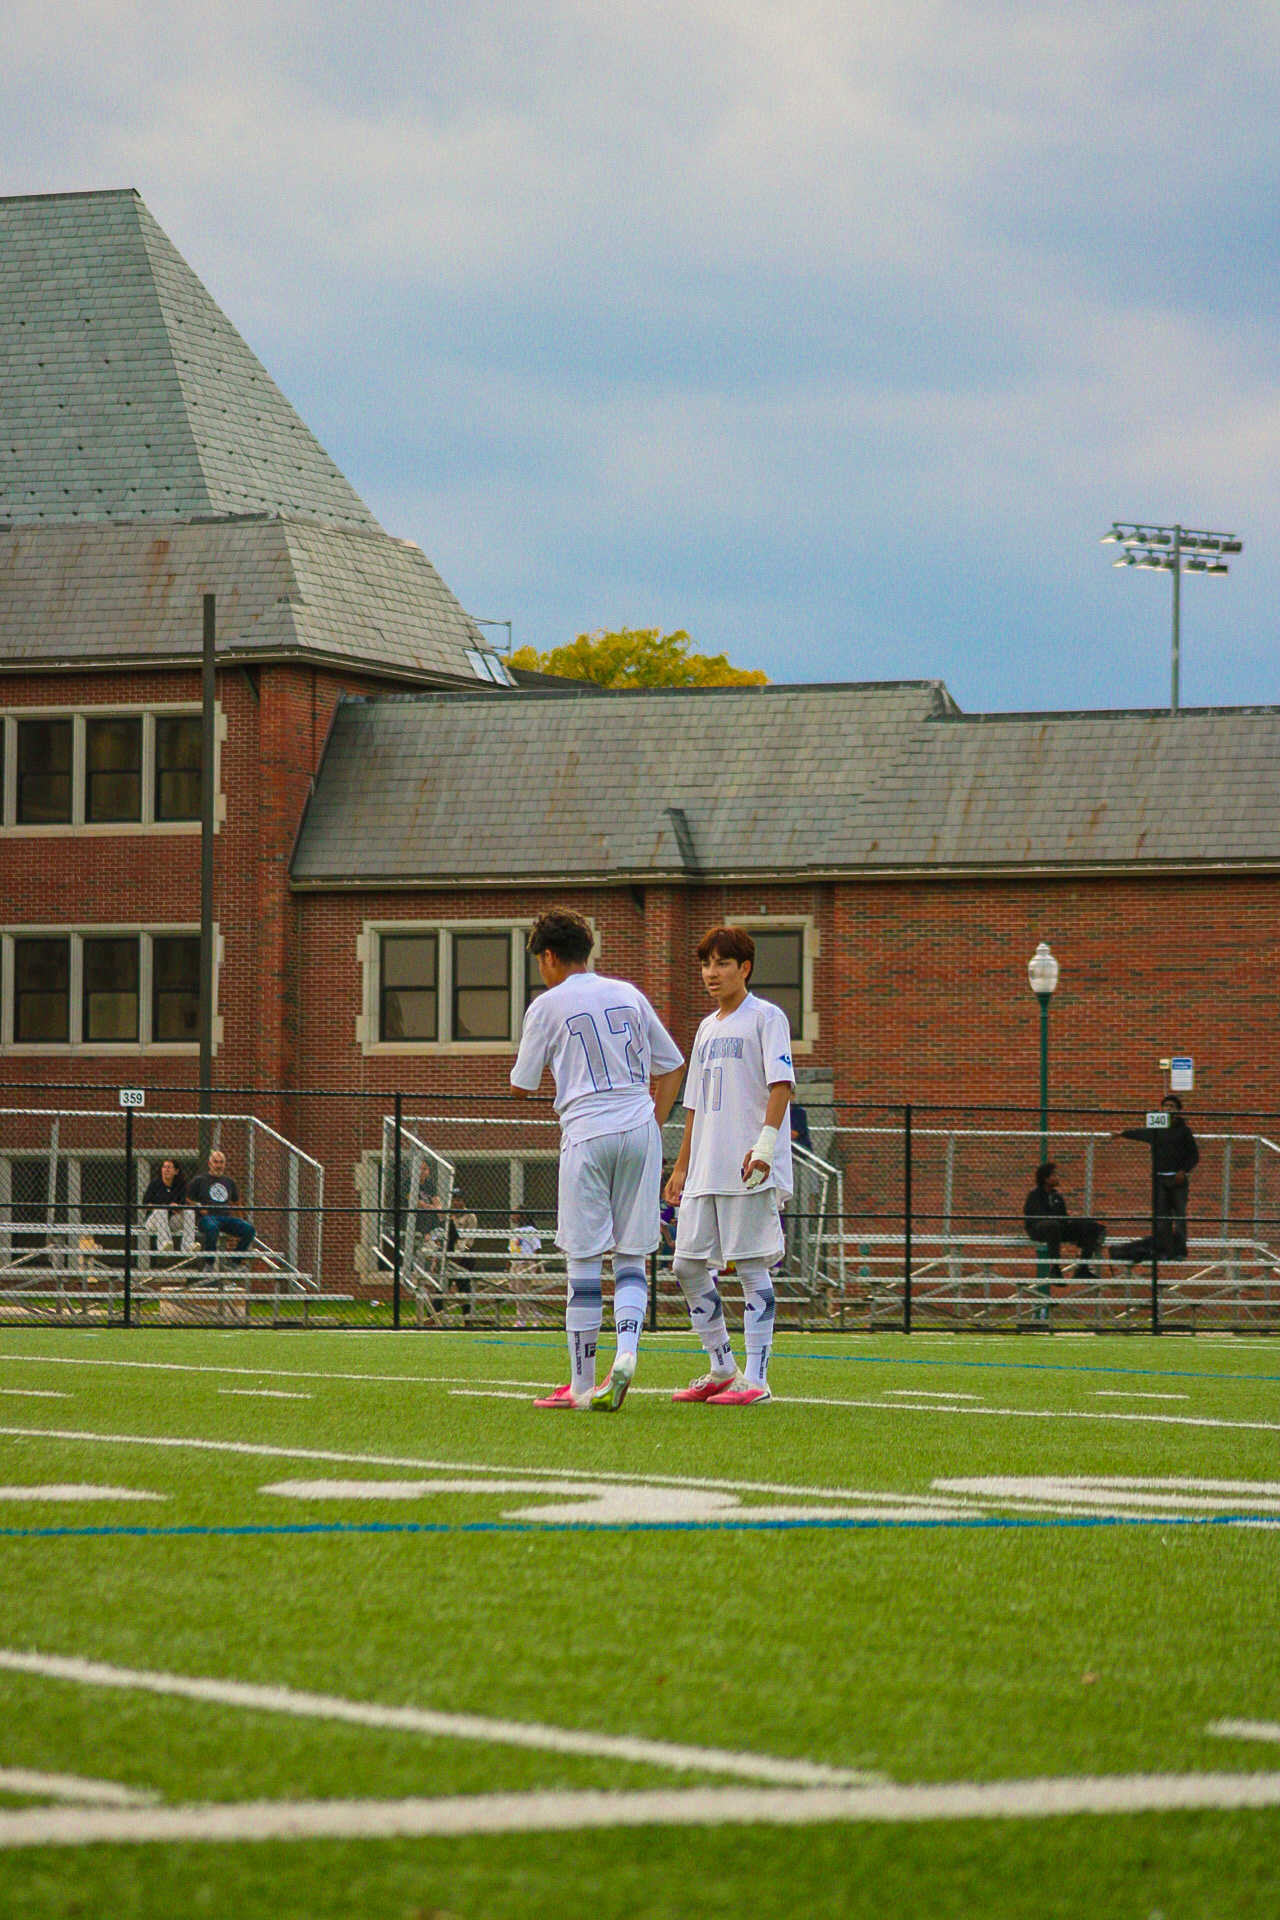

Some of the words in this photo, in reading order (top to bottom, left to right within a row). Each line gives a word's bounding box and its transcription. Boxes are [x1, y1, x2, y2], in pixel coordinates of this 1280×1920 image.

[701, 1066, 722, 1114] 11
[123, 1092, 142, 1104] 359
[1149, 1115, 1166, 1126] 340
[618, 1320, 637, 1333] FS
